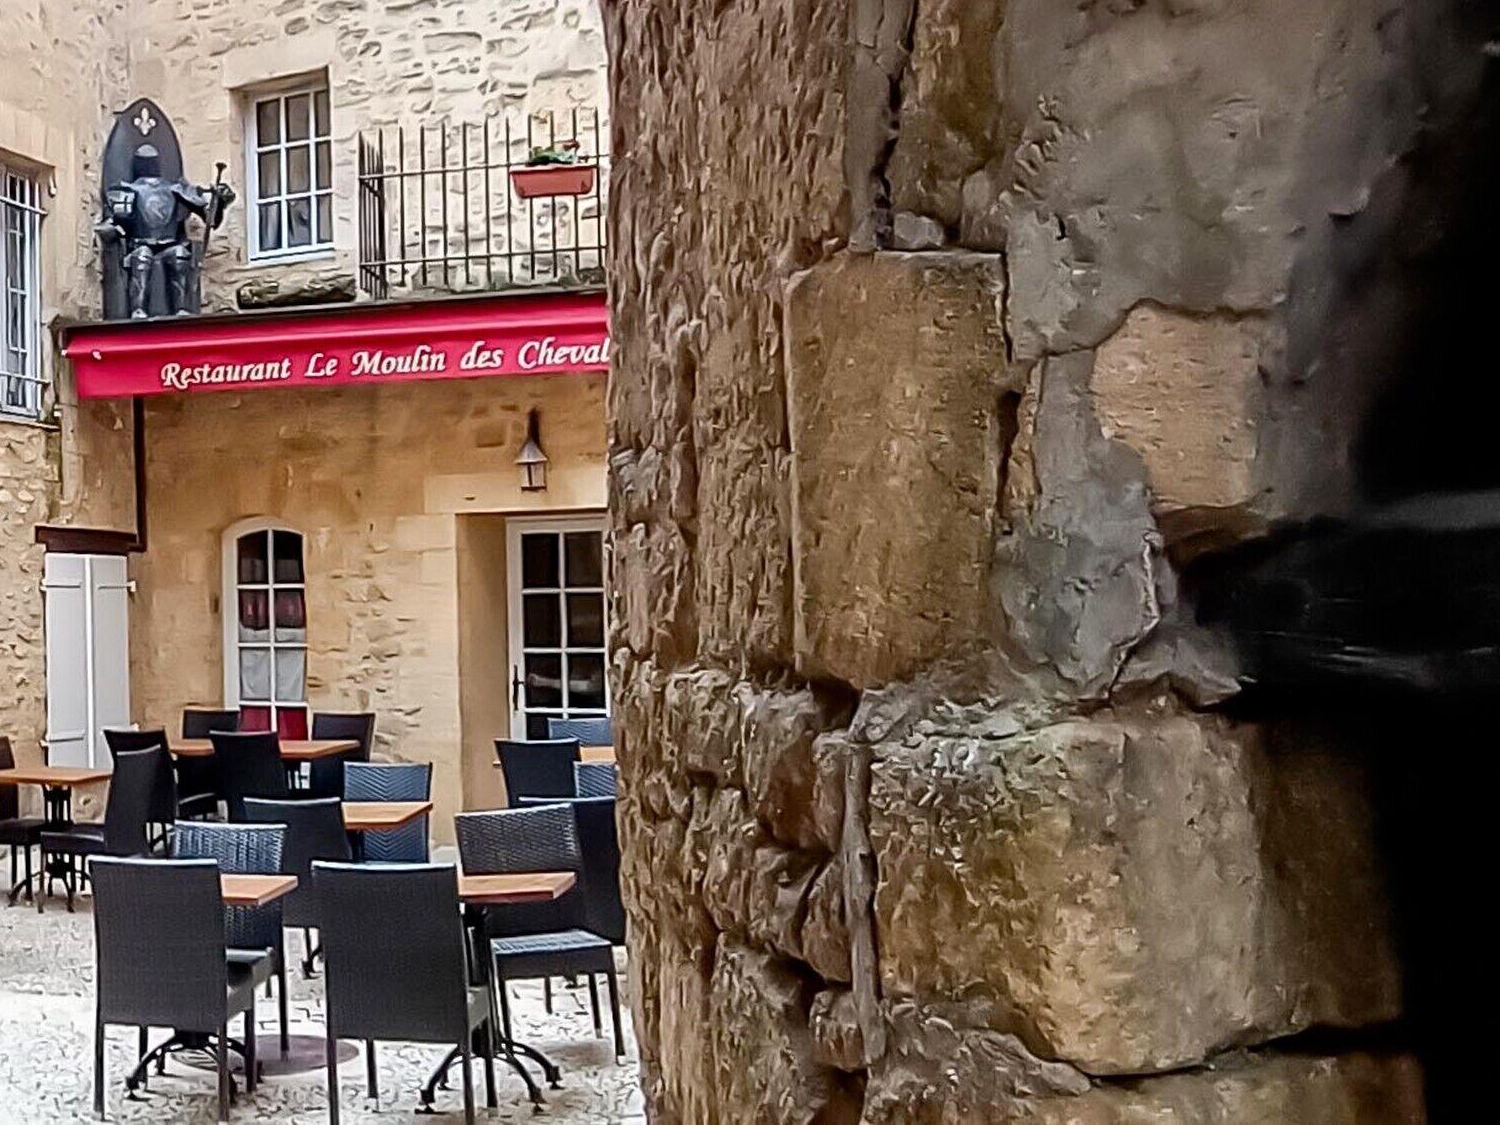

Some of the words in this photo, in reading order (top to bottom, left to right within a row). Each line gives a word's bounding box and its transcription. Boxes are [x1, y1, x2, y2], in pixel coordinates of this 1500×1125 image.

[161, 358, 291, 390] Restaurant
[304, 353, 338, 377] Le
[351, 344, 446, 376] Moulin
[460, 340, 504, 370] des
[518, 336, 611, 370] Cheval
